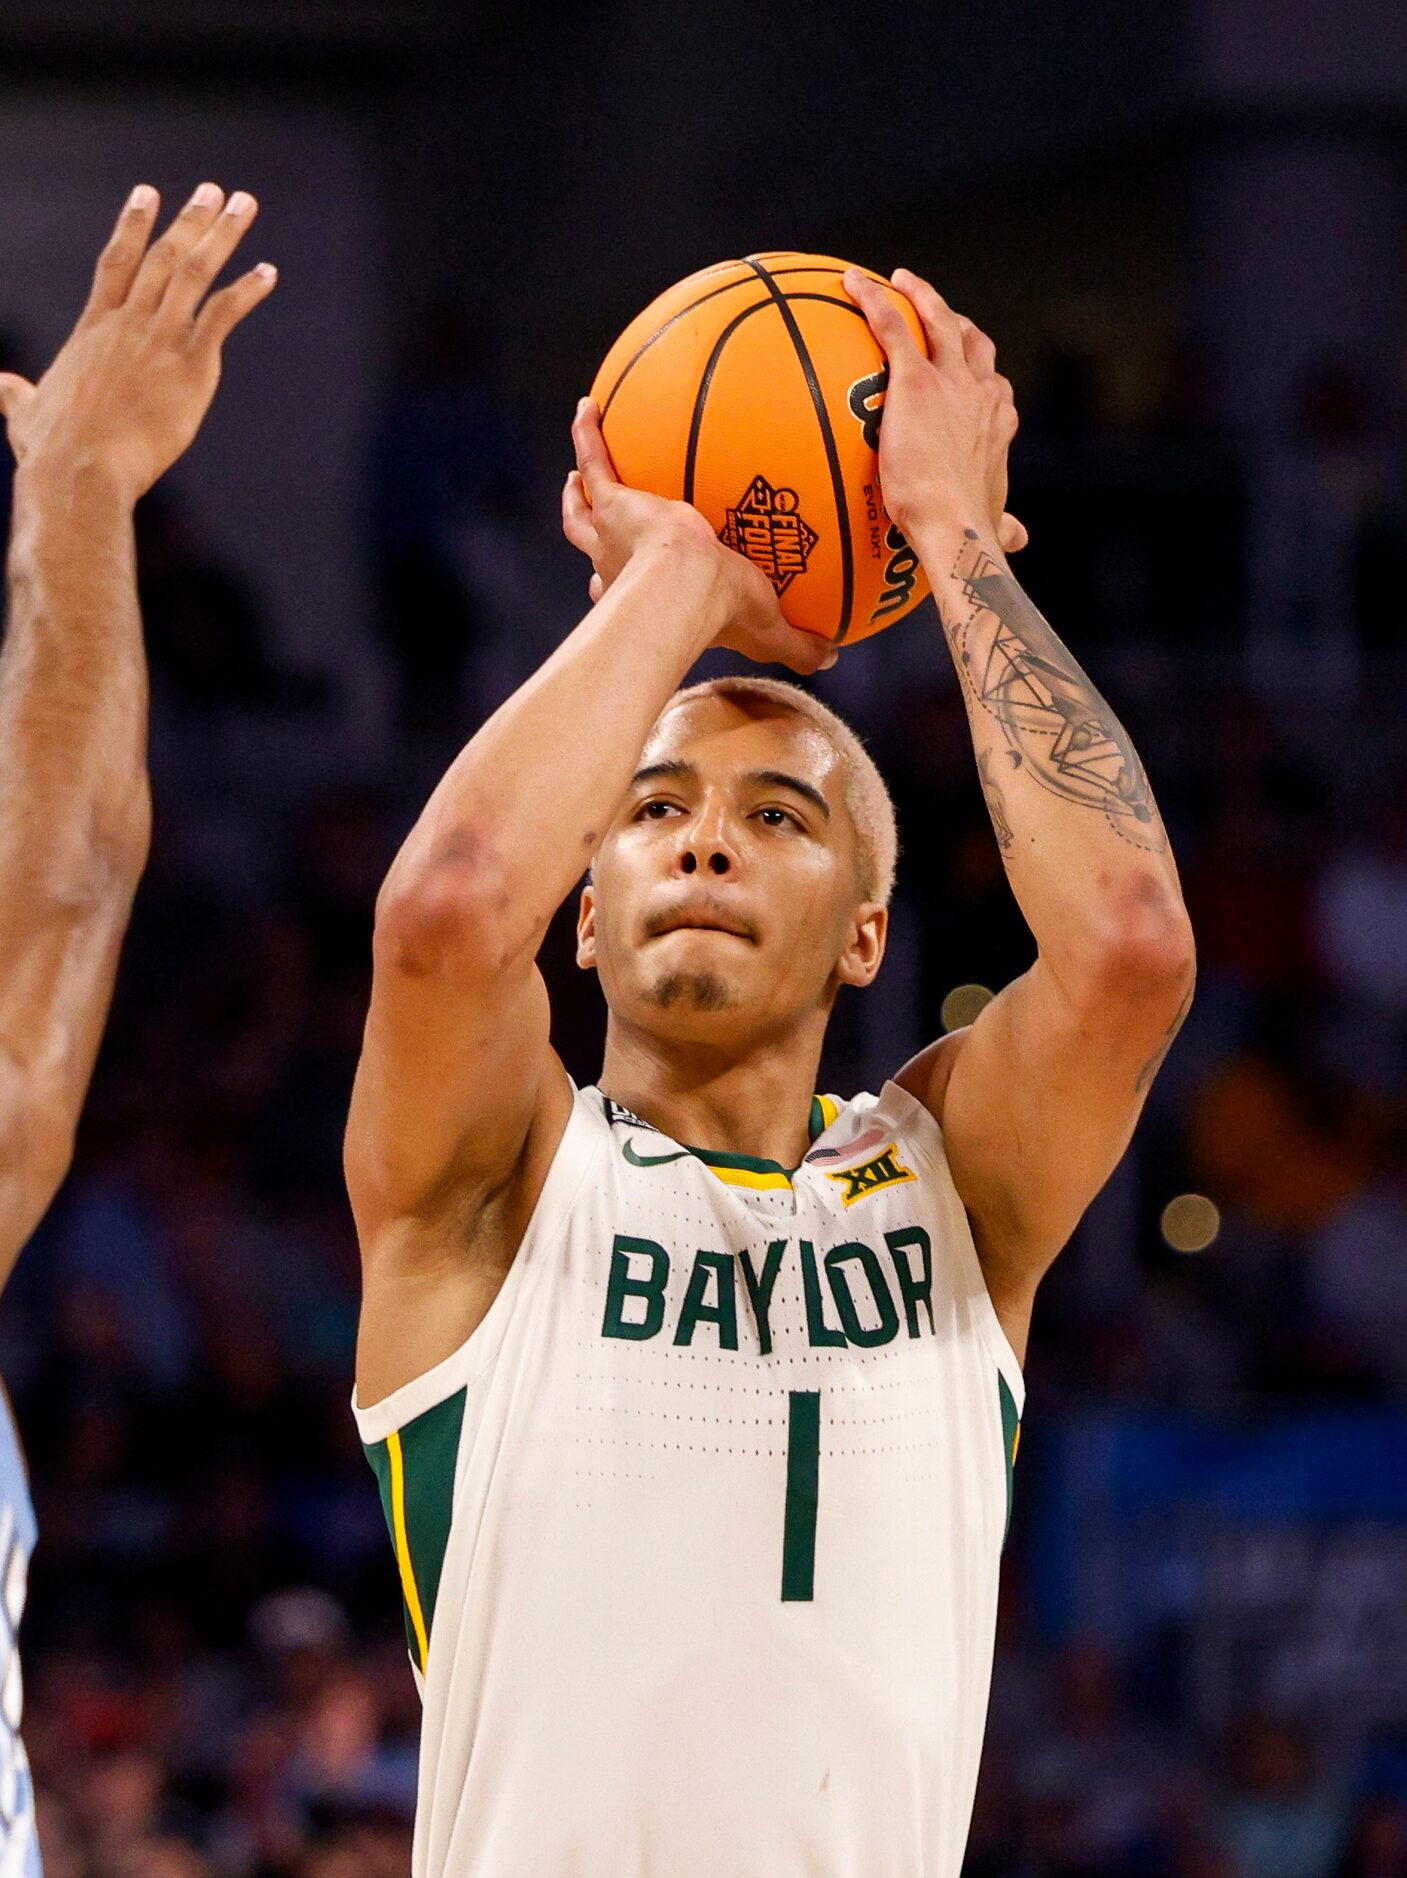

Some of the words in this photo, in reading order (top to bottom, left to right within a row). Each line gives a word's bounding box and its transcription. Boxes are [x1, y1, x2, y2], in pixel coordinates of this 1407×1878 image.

[863, 484, 878, 521] EVO
[771, 514, 804, 575] FINAL
[869, 526, 881, 560] NXT
[831, 1148, 909, 1200] XII
[601, 1226, 935, 1355] BAYLOR
[781, 1390, 821, 1602] 1
